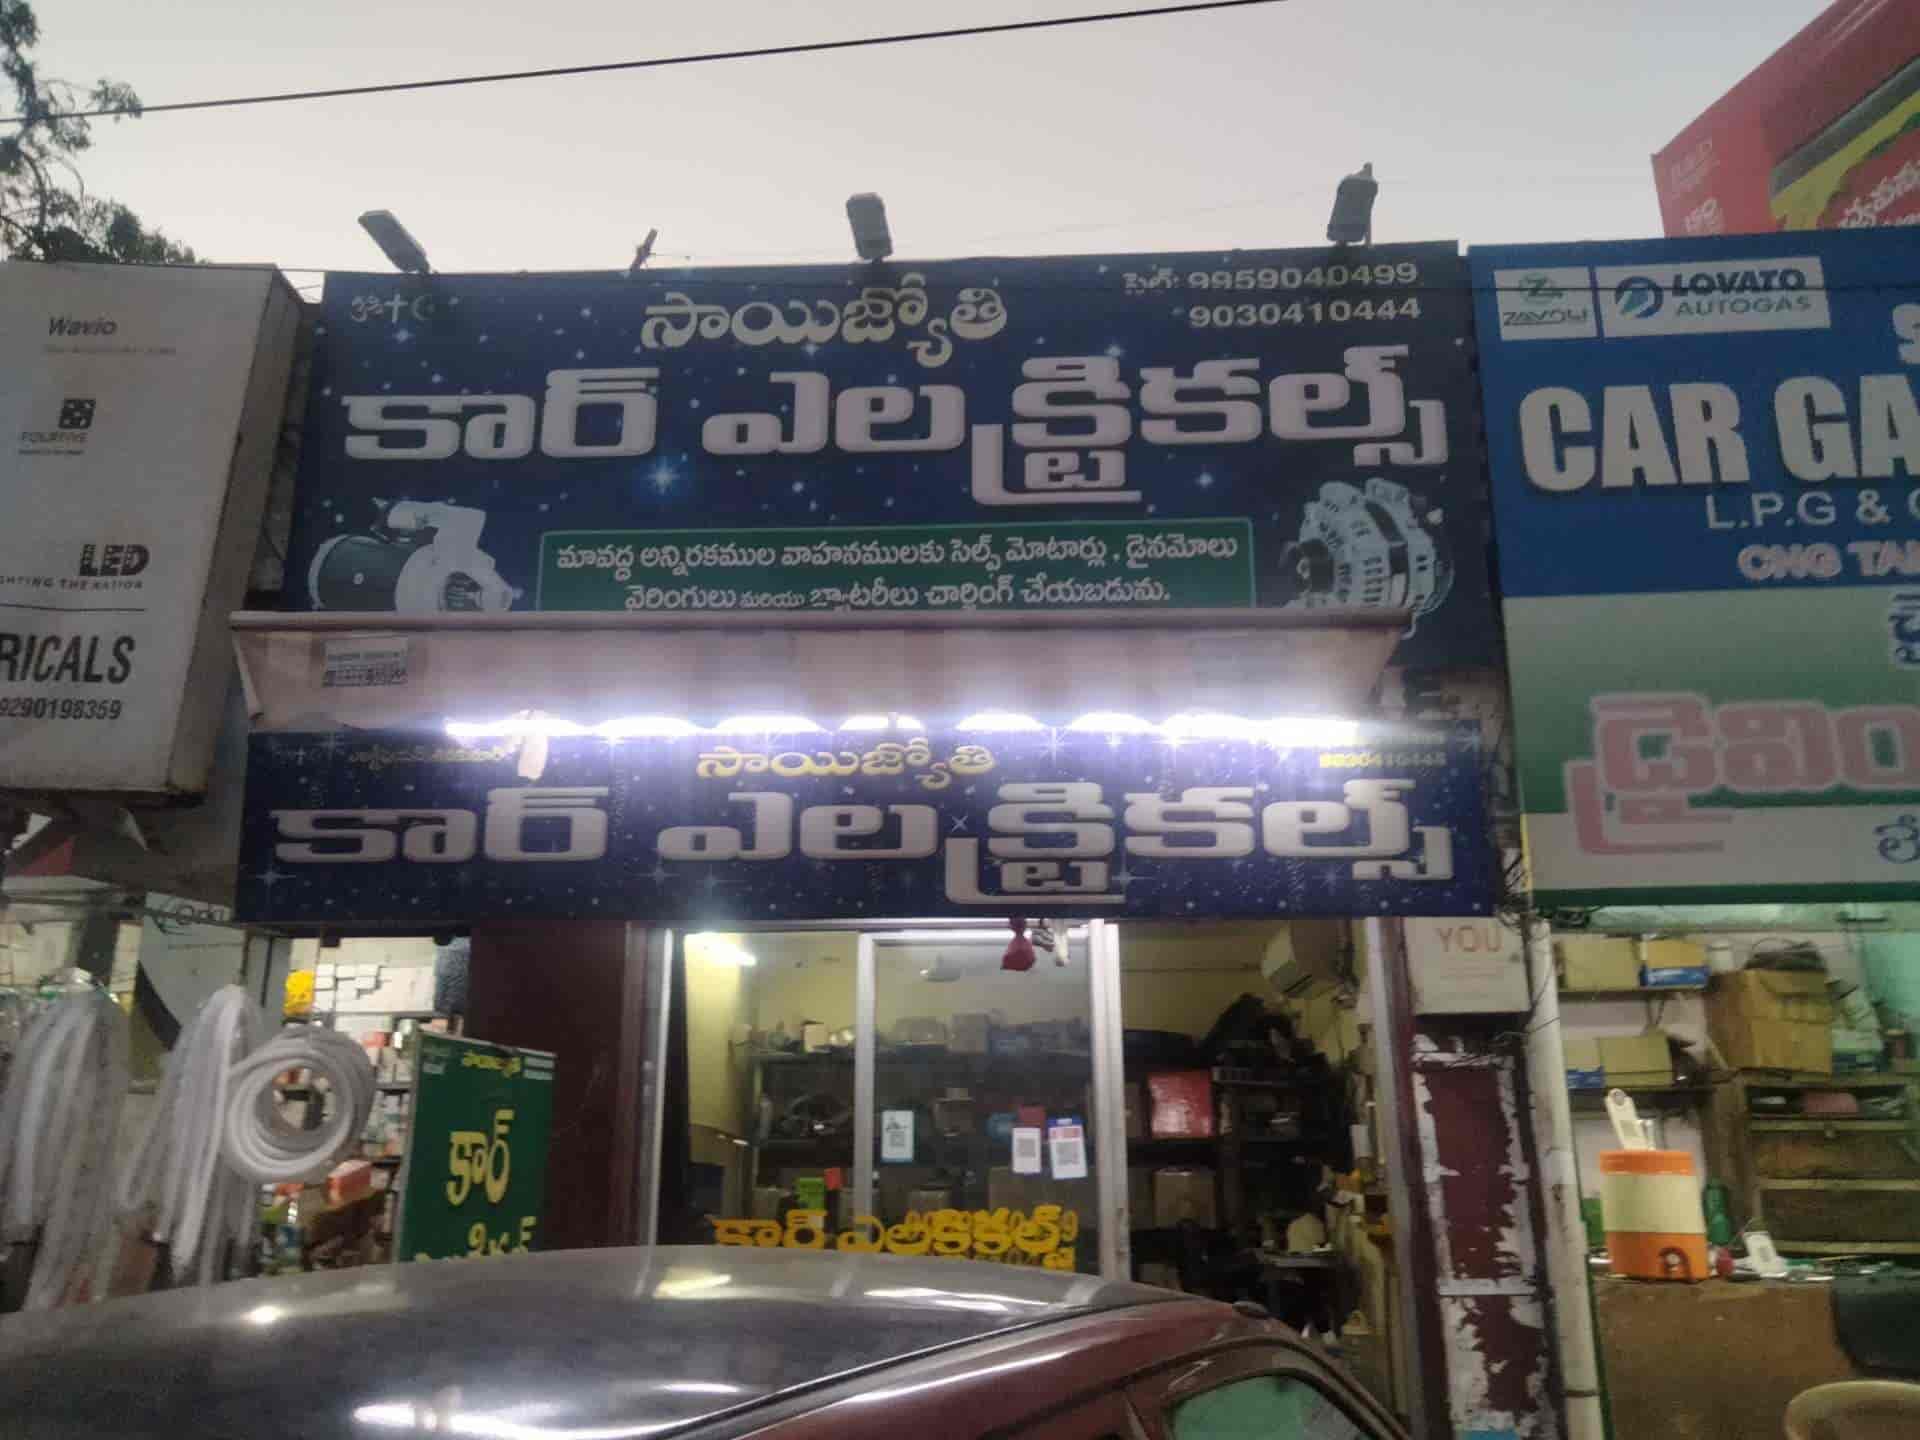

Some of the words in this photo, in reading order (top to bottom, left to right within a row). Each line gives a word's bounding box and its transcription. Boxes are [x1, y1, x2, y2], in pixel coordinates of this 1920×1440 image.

[1187, 262, 1418, 291] 9959040499
[1672, 269, 1806, 296] LOVATO
[641, 272, 1007, 368] సాయిజ్యోతి
[1190, 298, 1421, 327] 9030410444
[1675, 295, 1811, 317] AUTOGAS
[341, 367, 661, 460] కార్
[702, 344, 1449, 505] ఎలక్ట్రికల్స్
[1519, 381, 1750, 493] CAR
[1706, 490, 1837, 529] L.P.G
[1856, 488, 1891, 525] &
[80, 544, 150, 577] LED
[270, 786, 609, 865] కార్
[656, 779, 1453, 905] ఎలక్ట్రికల్స్
[1437, 925, 1504, 953] YOU
[446, 1108, 516, 1207] కార్
